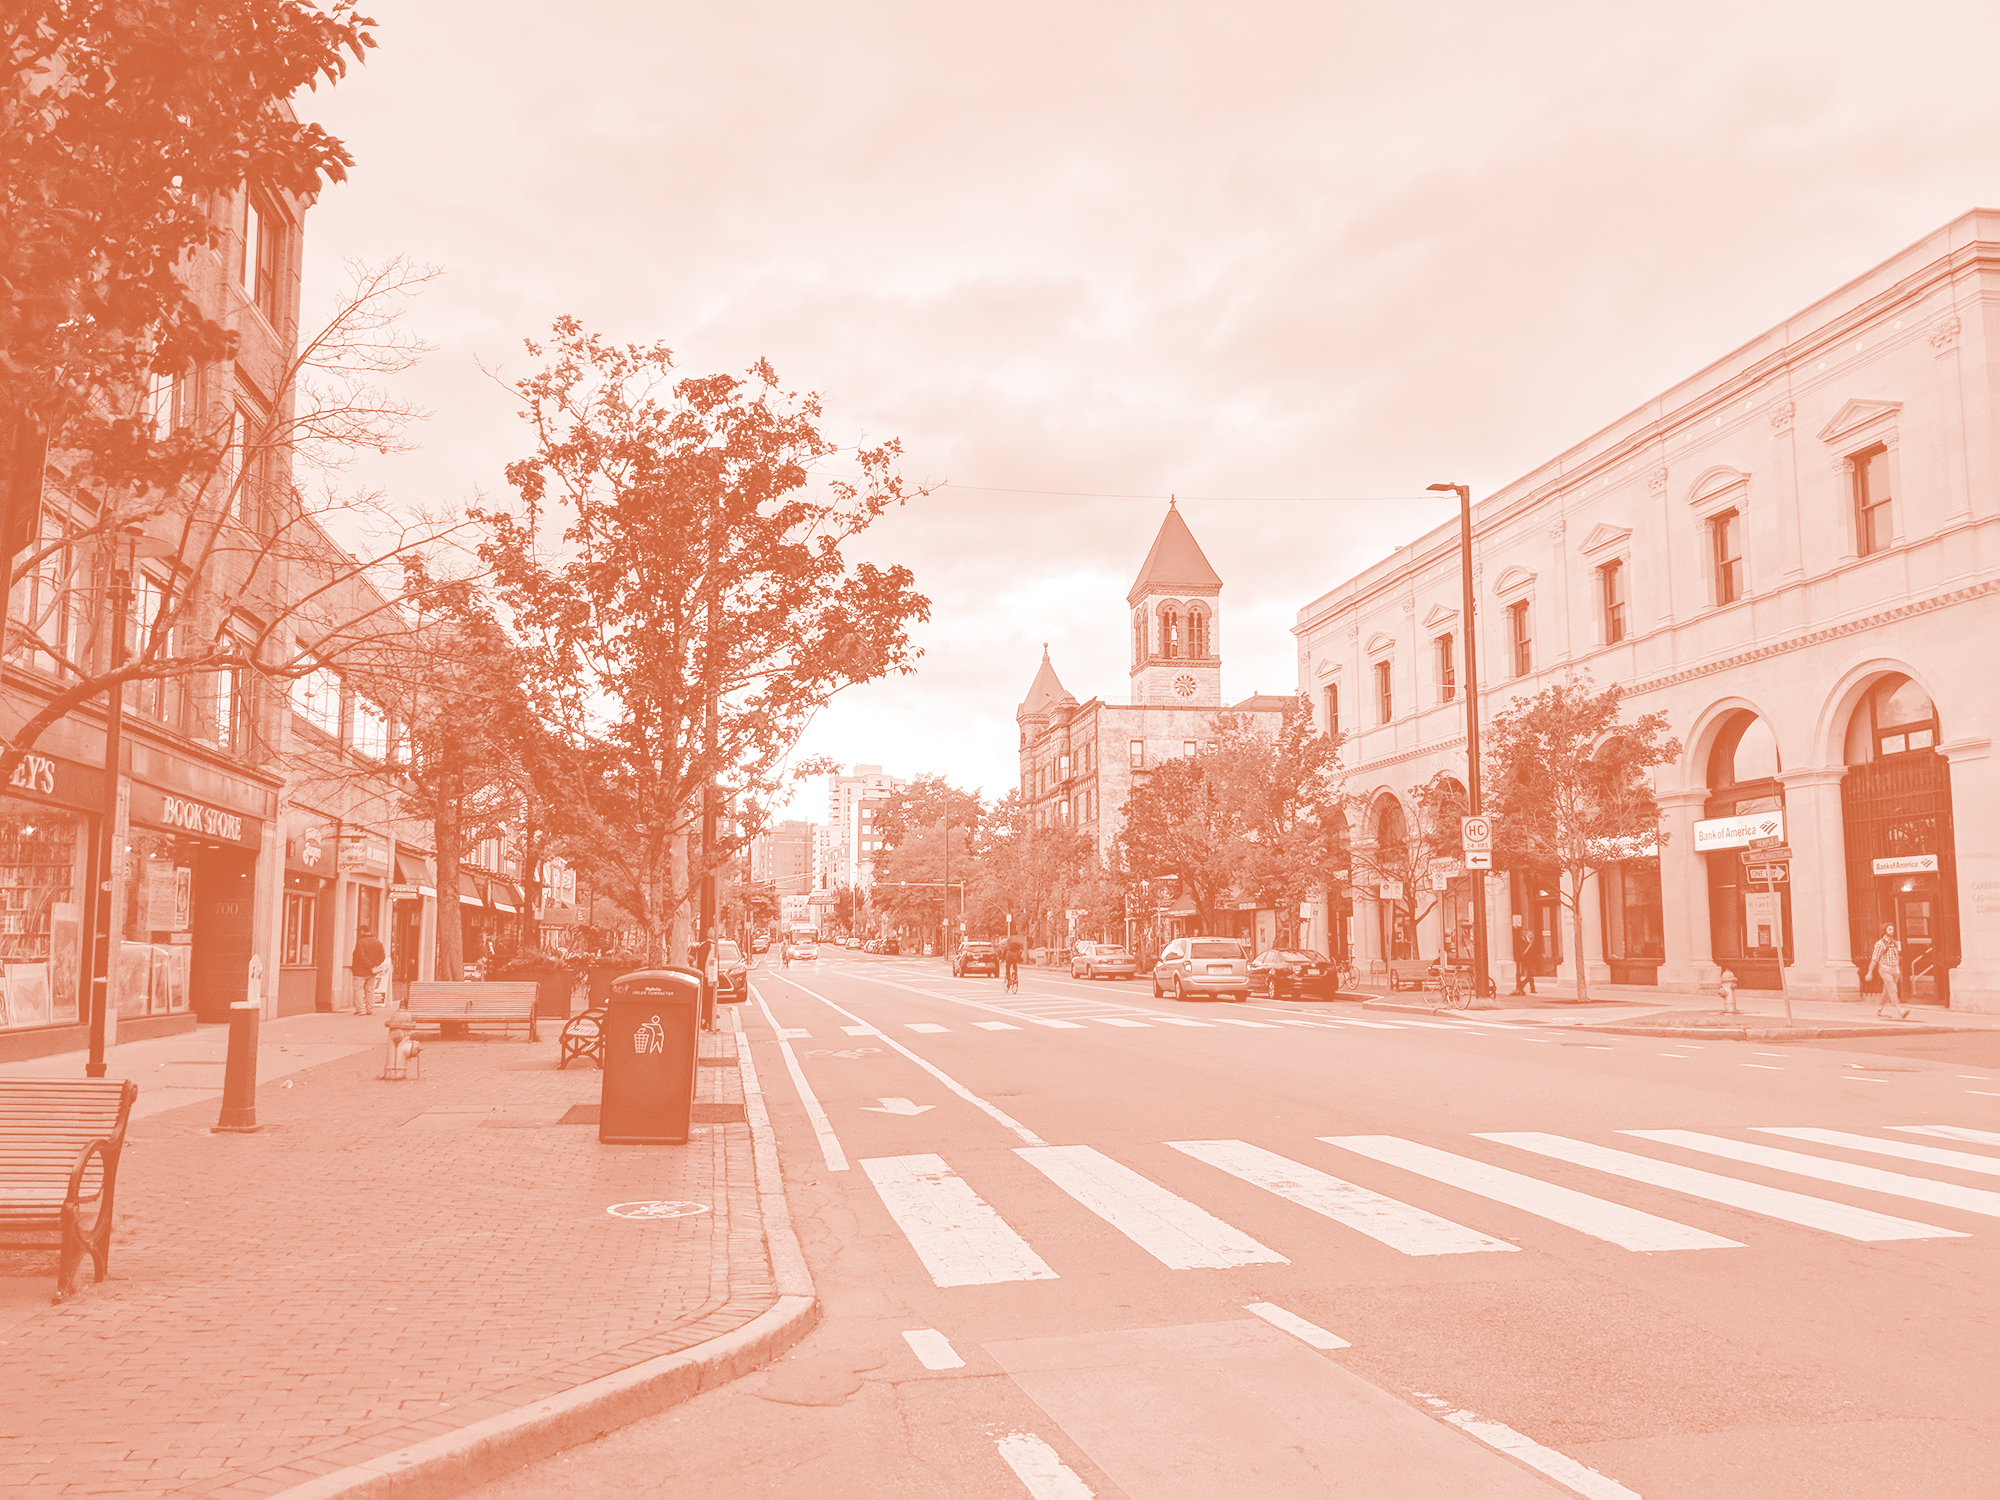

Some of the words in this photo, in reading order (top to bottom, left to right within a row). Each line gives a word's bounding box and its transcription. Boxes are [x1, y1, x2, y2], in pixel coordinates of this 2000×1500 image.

[161, 795, 204, 832] BOOK
[204, 808, 241, 840] STORE
[1469, 825, 1484, 836] HC
[1699, 831, 1717, 841] Bank
[1717, 828, 1726, 840] of
[1725, 825, 1756, 838] America
[1876, 862, 1890, 871] Bank
[1889, 861, 1896, 870] of
[1896, 861, 1918, 869] America
[1751, 870, 1765, 878] ONE
[213, 902, 239, 916] 700
